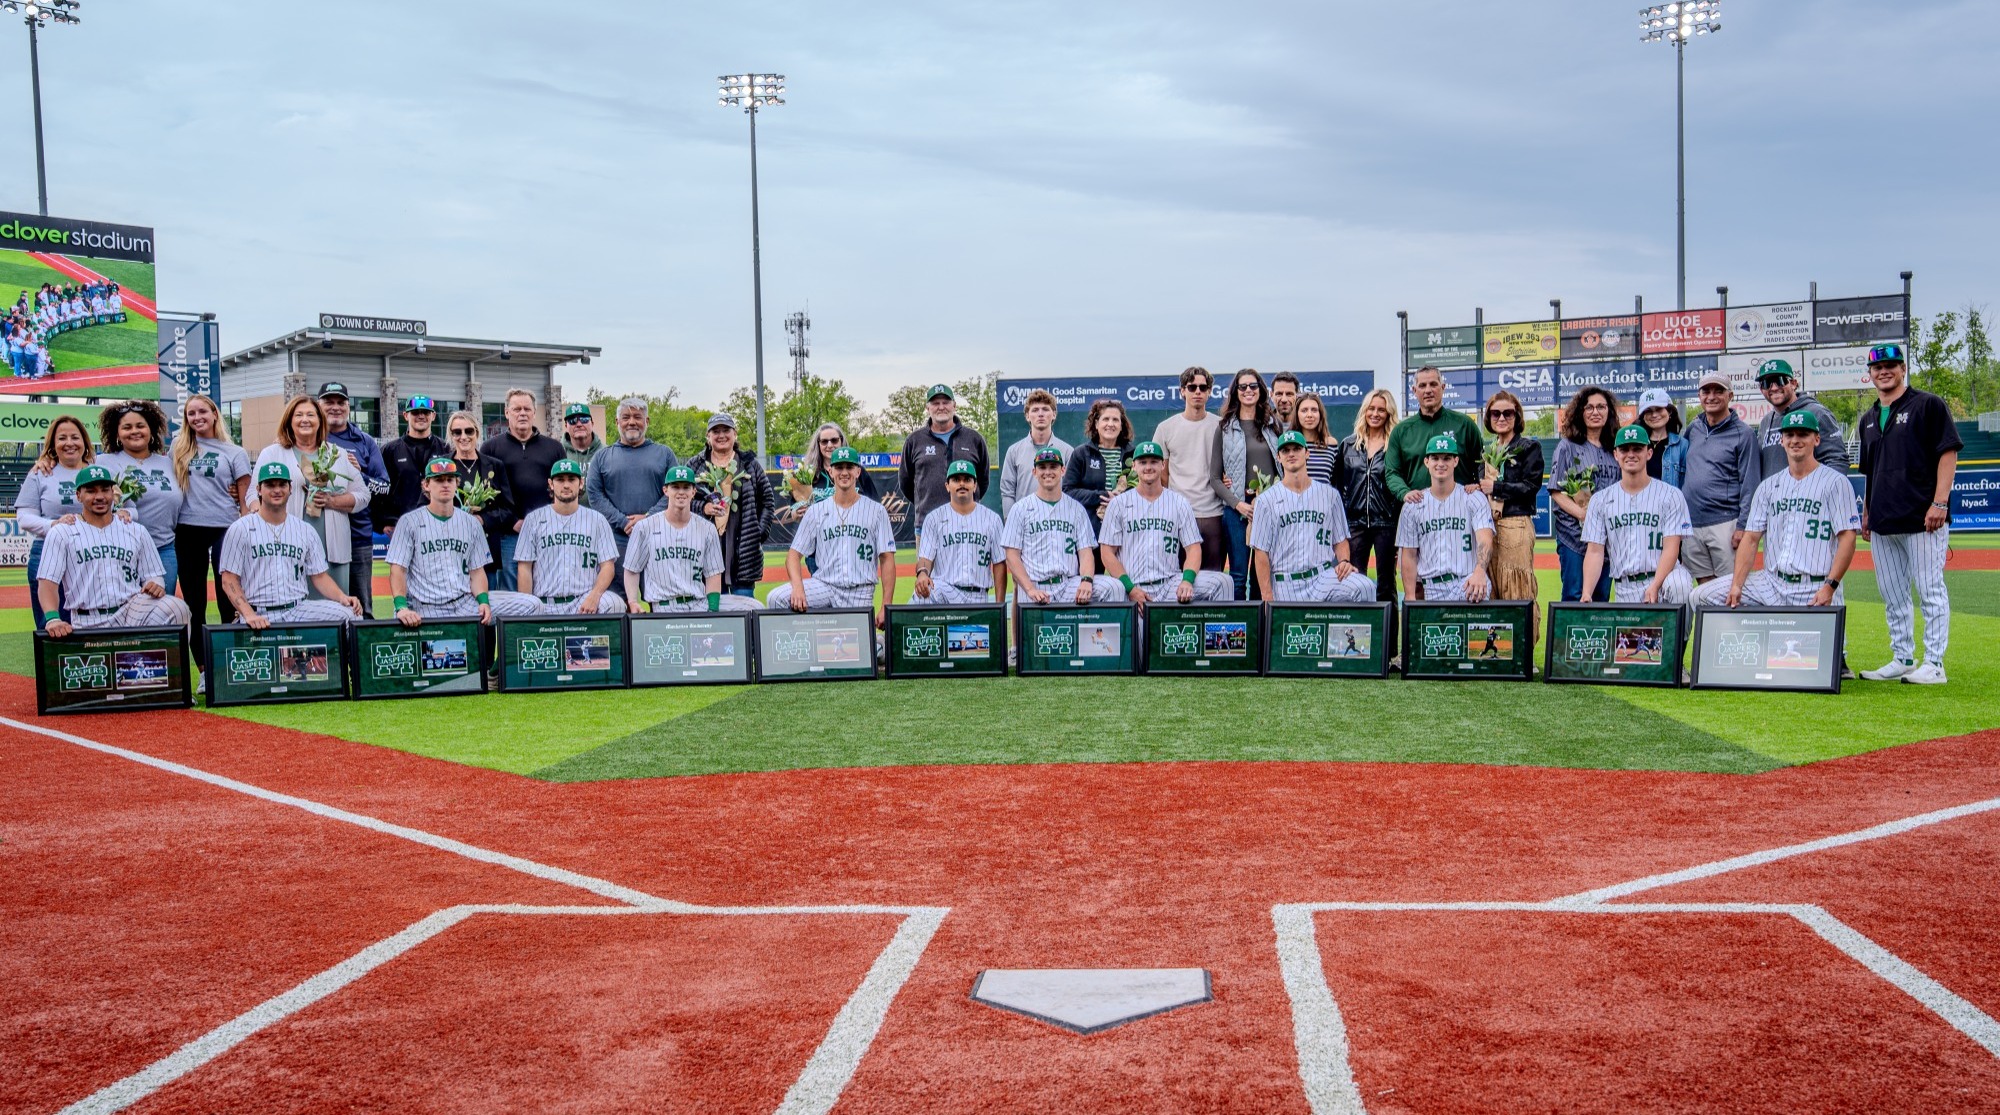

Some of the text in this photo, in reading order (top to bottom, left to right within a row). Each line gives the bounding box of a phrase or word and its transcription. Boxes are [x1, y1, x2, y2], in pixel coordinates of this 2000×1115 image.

[335, 317, 412, 332] TOWN OF RAMAPO
[1562, 316, 1639, 330] LABORERS RISING
[1665, 315, 1700, 328] IUOE
[1526, 333, 1540, 342] 363
[1644, 326, 1722, 342] LOCAL 825
[1499, 368, 1554, 388] CSEA
[1559, 369, 1645, 386] Montefiore
[1076, 387, 1117, 395] Samaritan
[1127, 387, 1165, 400] Care
[1300, 382, 1362, 396] istance.
[1790, 414, 1803, 424] M
[1896, 413, 1908, 424] M
[1284, 432, 1295, 442] M
[1624, 430, 1637, 439] M
[1143, 445, 1154, 453] M
[1436, 440, 1448, 449] M
[838, 450, 849, 459] M
[860, 455, 879, 465] PLAY
[90, 468, 104, 478] M
[269, 465, 282, 474] M
[560, 462, 572, 471] M
[956, 462, 967, 471] M
[676, 469, 687, 478] M
[1772, 498, 1822, 516] JASPERS
[1962, 499, 1988, 508] Nyack
[1280, 510, 1325, 528] JASPERS
[1608, 512, 1660, 531] JASPERS
[823, 524, 868, 541] JASPERS
[1030, 519, 1075, 534] JASPERS
[1127, 518, 1174, 534] JASPERS
[1420, 517, 1467, 536] JASPERS
[1805, 519, 1832, 540] 33
[541, 533, 592, 549] JASPERS
[943, 532, 987, 547] JASPERS
[1462, 534, 1472, 552] 3
[1648, 532, 1663, 550] 10
[251, 543, 303, 560] JASPERS
[421, 539, 469, 555] JASPERS
[857, 544, 873, 561] 42
[76, 545, 133, 564] JASPERS
[582, 552, 598, 568] 15
[655, 547, 701, 562] JASPERS
[1168, 634, 1195, 643] JASPERS
[1290, 636, 1318, 644] JASPERS
[1429, 637, 1457, 645] JASPERS
[525, 650, 555, 659] JASPERS
[1723, 644, 1756, 653] JASPERS
[235, 661, 268, 670] JASPERS
[380, 655, 411, 665] JASPERS
[68, 667, 103, 677] JASPERS
